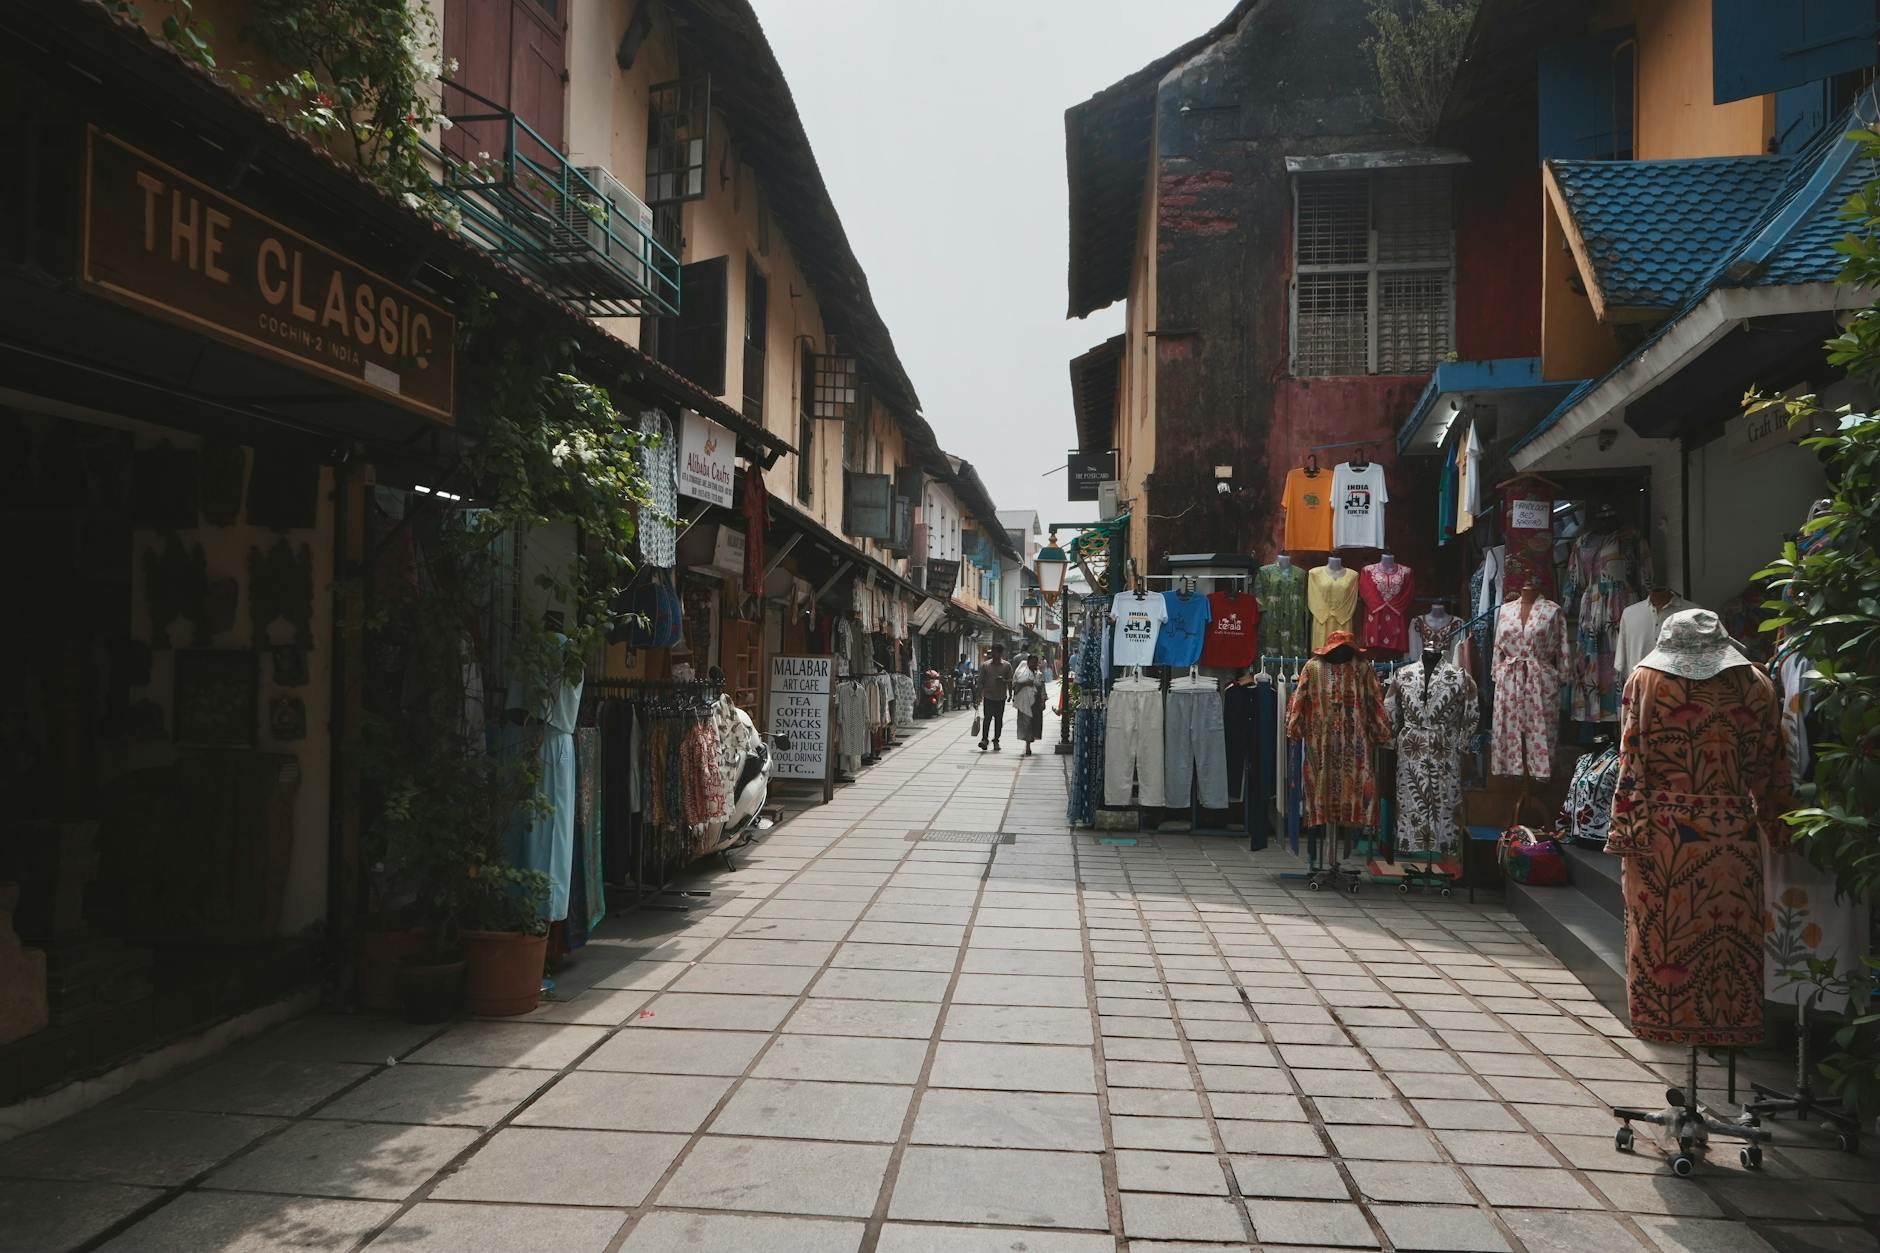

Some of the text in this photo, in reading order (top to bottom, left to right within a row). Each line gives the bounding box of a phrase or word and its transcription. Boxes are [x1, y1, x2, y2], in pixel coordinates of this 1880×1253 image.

[136, 170, 432, 369] THE CLASSIC
[258, 313, 359, 366] COCHIN-2 INDIA
[774, 659, 828, 676] MALABAR
[783, 679, 819, 691] ART CAFE
[788, 696, 811, 706] TEA
[777, 707, 821, 717] COFFEE
[776, 718, 821, 729] SNACKS
[799, 742, 824, 752] JUICE
[772, 752, 822, 763] COOL DRINKS
